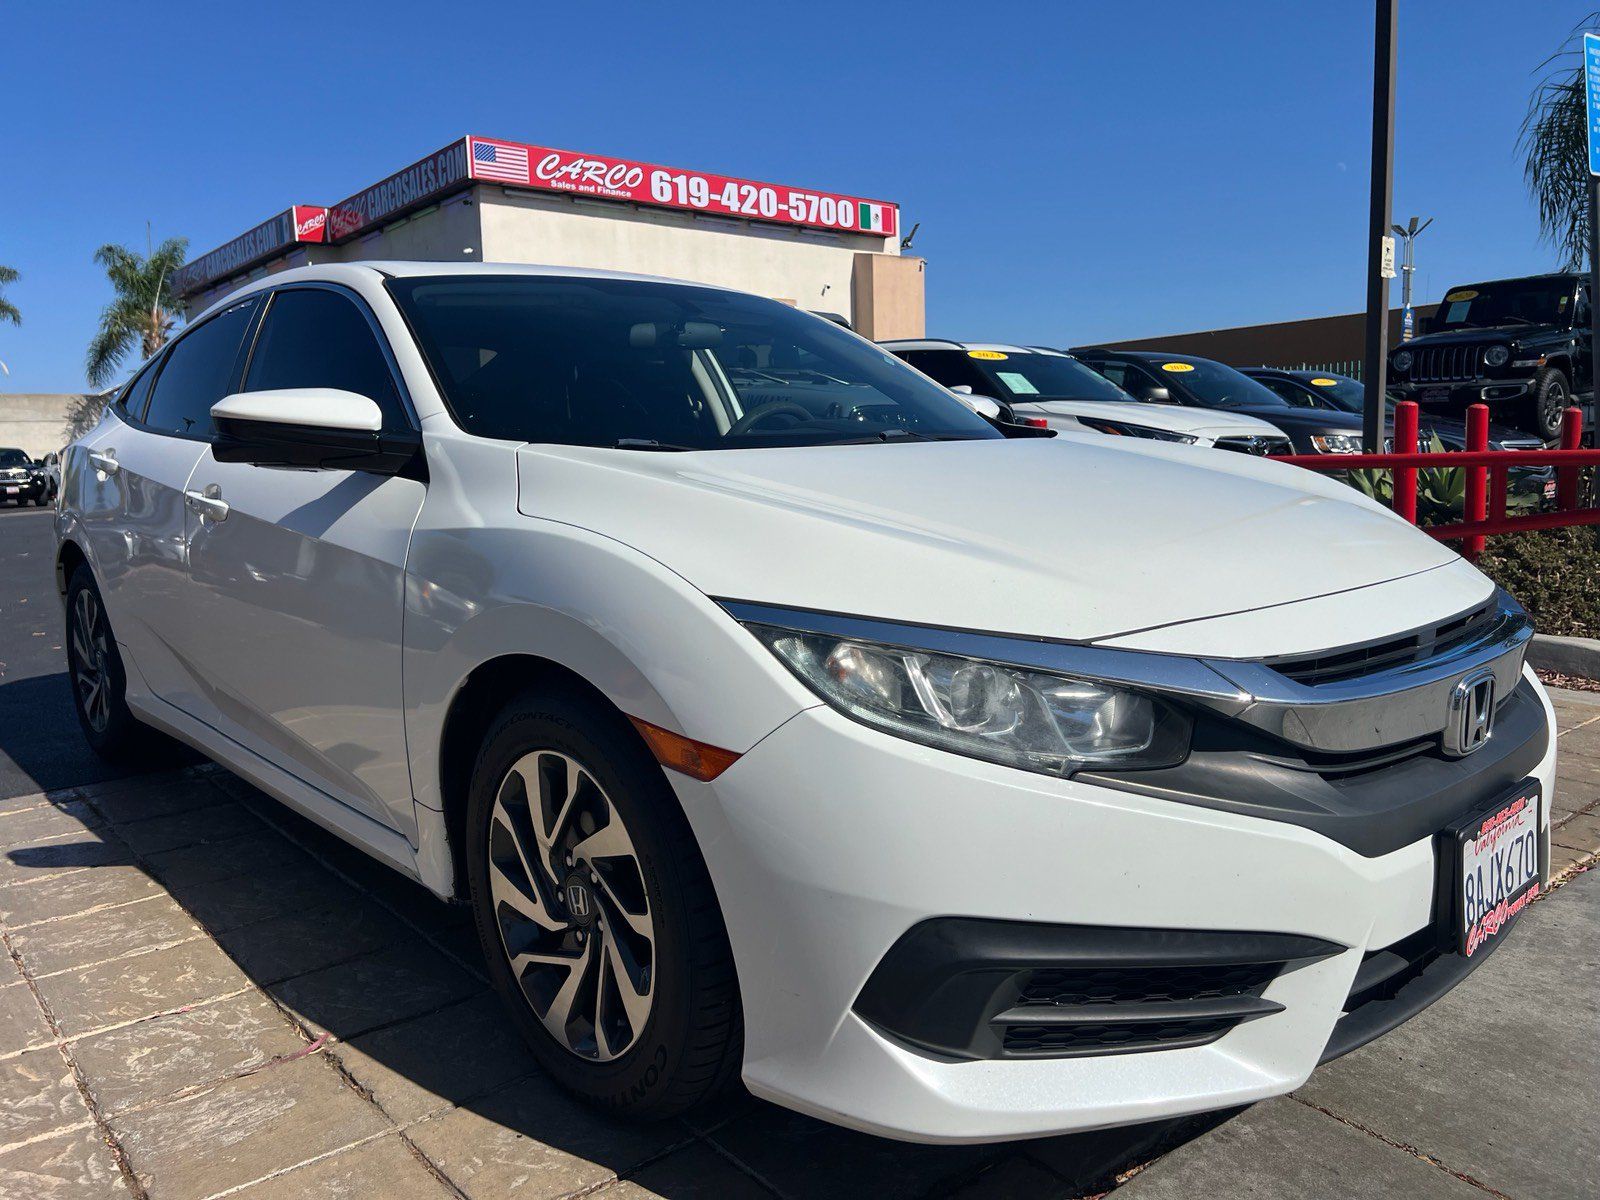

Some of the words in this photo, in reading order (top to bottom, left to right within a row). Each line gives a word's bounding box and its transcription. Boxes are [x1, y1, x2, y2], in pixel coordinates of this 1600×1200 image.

[367, 143, 467, 221] CARCOSALES.COM
[535, 153, 644, 189] CARCO
[650, 169, 855, 229] 619-420-5700
[550, 179, 577, 191] Sales
[578, 182, 596, 193] and
[597, 185, 632, 198] Finance
[206, 221, 278, 280] CARCOSALES.COM
[297, 214, 326, 234] CARCO
[1474, 814, 1525, 856] California
[1465, 829, 1535, 927] 8AJX670
